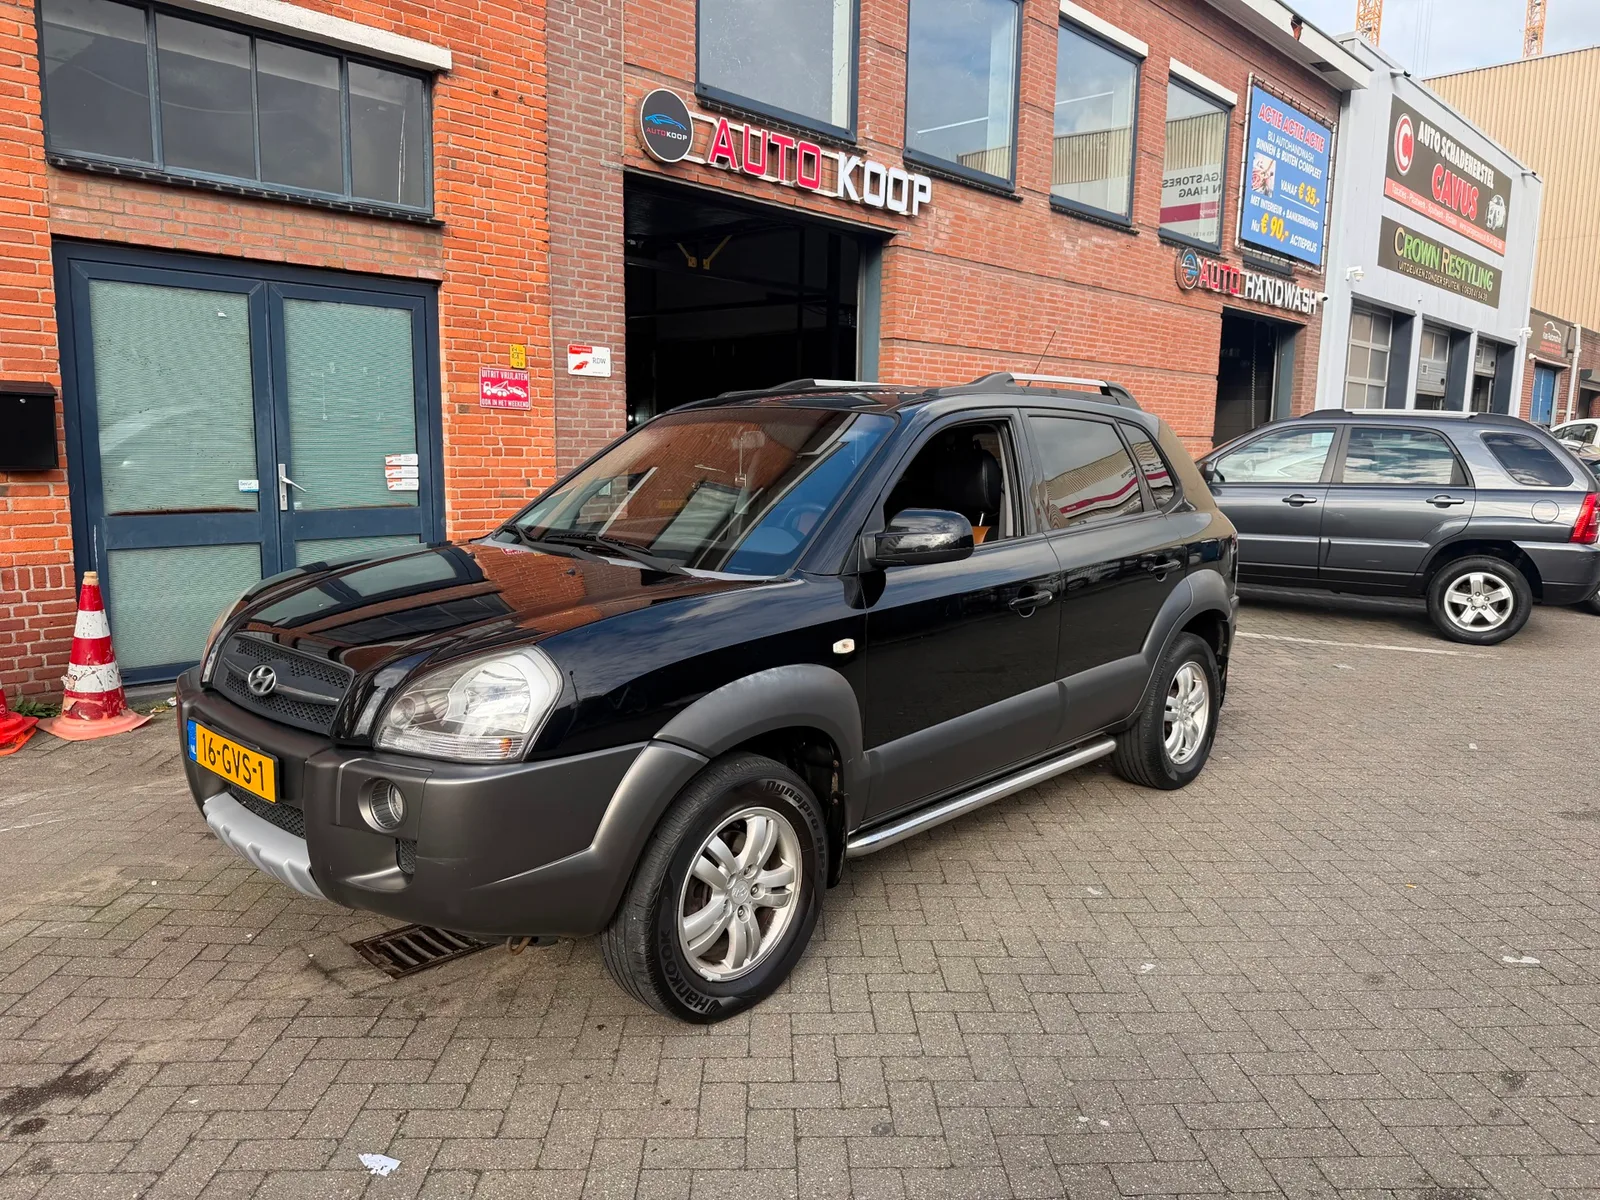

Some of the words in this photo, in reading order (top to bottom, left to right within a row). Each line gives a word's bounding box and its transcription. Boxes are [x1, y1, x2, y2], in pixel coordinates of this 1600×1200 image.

[645, 126, 688, 141] AUTOKOOP
[1258, 102, 1283, 130] ACTIE
[1283, 116, 1305, 142] ACTIE
[1305, 129, 1325, 153] ACTIE
[707, 117, 821, 190] AUTO
[837, 151, 932, 216] KOOP
[1256, 138, 1275, 156] BINNEN
[1276, 147, 1281, 158] &
[1281, 150, 1298, 167] BUITEN
[1298, 160, 1322, 179] COMPLEET
[1276, 135, 1314, 163] AUTOHANDWASH
[1417, 120, 1440, 154] AUTO
[1441, 136, 1495, 190] SCHADEHERSTEL
[1250, 195, 1259, 206] MET
[1260, 198, 1282, 216] INTERIEUR
[1280, 180, 1298, 196] VANAF
[1298, 182, 1305, 199] €
[1431, 163, 1480, 221] CAVUS
[1261, 212, 1269, 235] €
[1290, 234, 1318, 253] ACTIEPRIJS
[1394, 226, 1440, 270] CROWN
[1441, 248, 1494, 292] RESTYLING
[1198, 257, 1240, 296] AUTO
[1245, 272, 1317, 315] HANDWASH
[481, 369, 499, 379] UITRIT
[500, 370, 528, 380] VRIJLATEN
[508, 400, 529, 408] WEEKEND
[202, 733, 264, 791] 16-GVS-1
